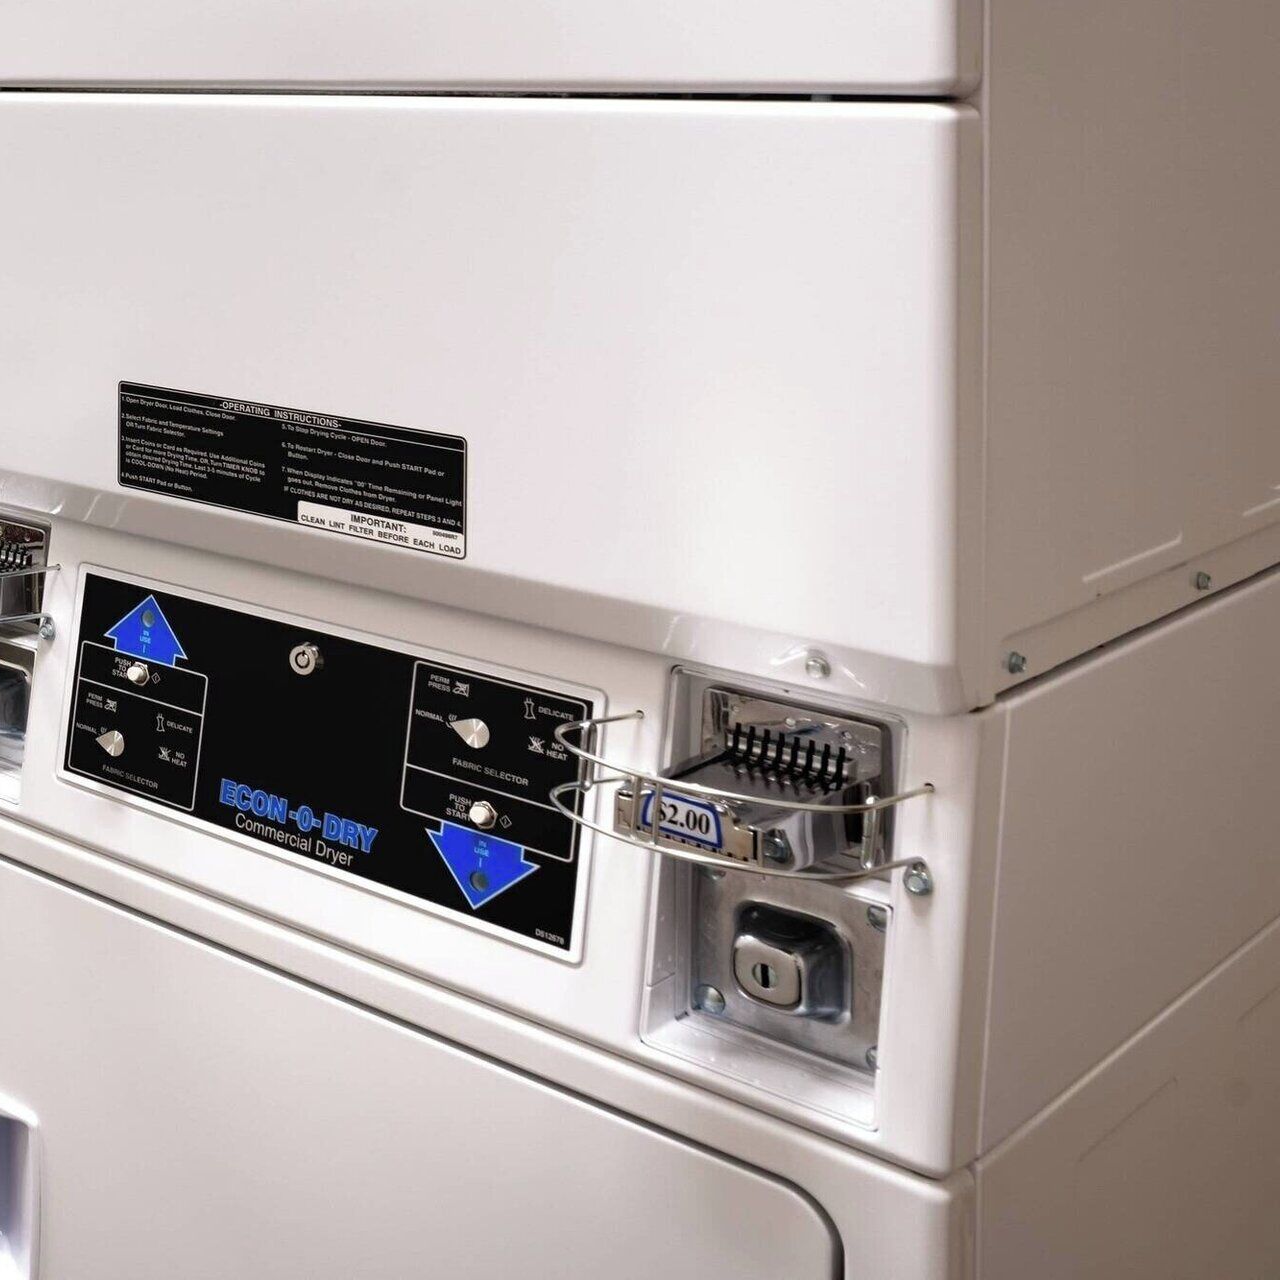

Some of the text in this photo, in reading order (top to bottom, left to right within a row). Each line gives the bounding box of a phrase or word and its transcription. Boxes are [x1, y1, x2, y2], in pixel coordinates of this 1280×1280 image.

[402, 464, 422, 472] START
[351, 514, 406, 533] IMPORTANT:
[301, 515, 461, 555] CLEAN LINT FILTER BEFORE EACH LOAD
[114, 656, 132, 666] PUSH
[112, 669, 128, 679] STAR
[118, 664, 127, 672] TO
[430, 673, 450, 684] PERM
[427, 681, 451, 693] PRESS
[88, 692, 103, 701] PERM
[85, 698, 103, 709] PRESS
[415, 708, 443, 722] NORMAL
[538, 706, 574, 720] DELICATE
[75, 722, 97, 734] NORMAL
[166, 720, 193, 734] DELICATE
[551, 742, 564, 751] NO
[175, 751, 185, 759] NO
[546, 750, 568, 762] HEAT
[171, 758, 188, 768] HEAT
[102, 764, 159, 789] FABRIC SELECTOR
[452, 757, 529, 786] FABRIC SELECTOR
[448, 793, 472, 807] PUSH
[454, 803, 466, 812] TO
[657, 801, 710, 835] $2.00
[235, 812, 354, 867] Commercial Dryer
[474, 847, 489, 857] USE
